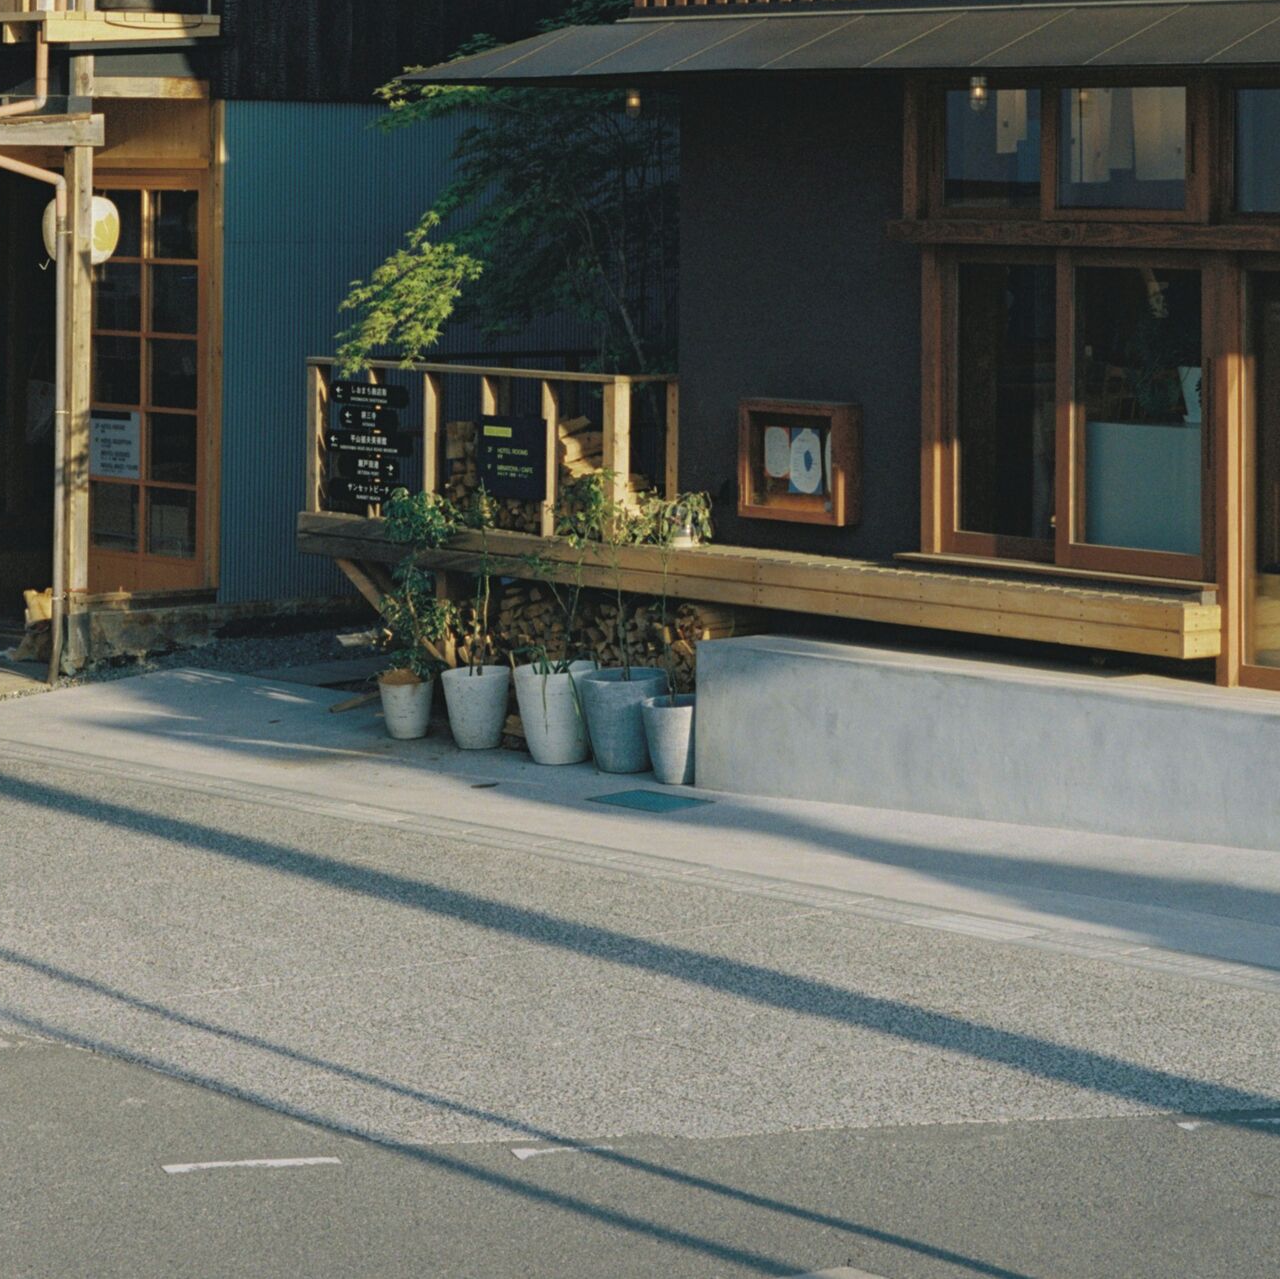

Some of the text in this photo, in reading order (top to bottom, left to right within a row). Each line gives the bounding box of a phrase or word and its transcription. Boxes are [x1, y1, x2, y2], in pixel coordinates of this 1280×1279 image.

[348, 483, 389, 494] サンセットビーチ
